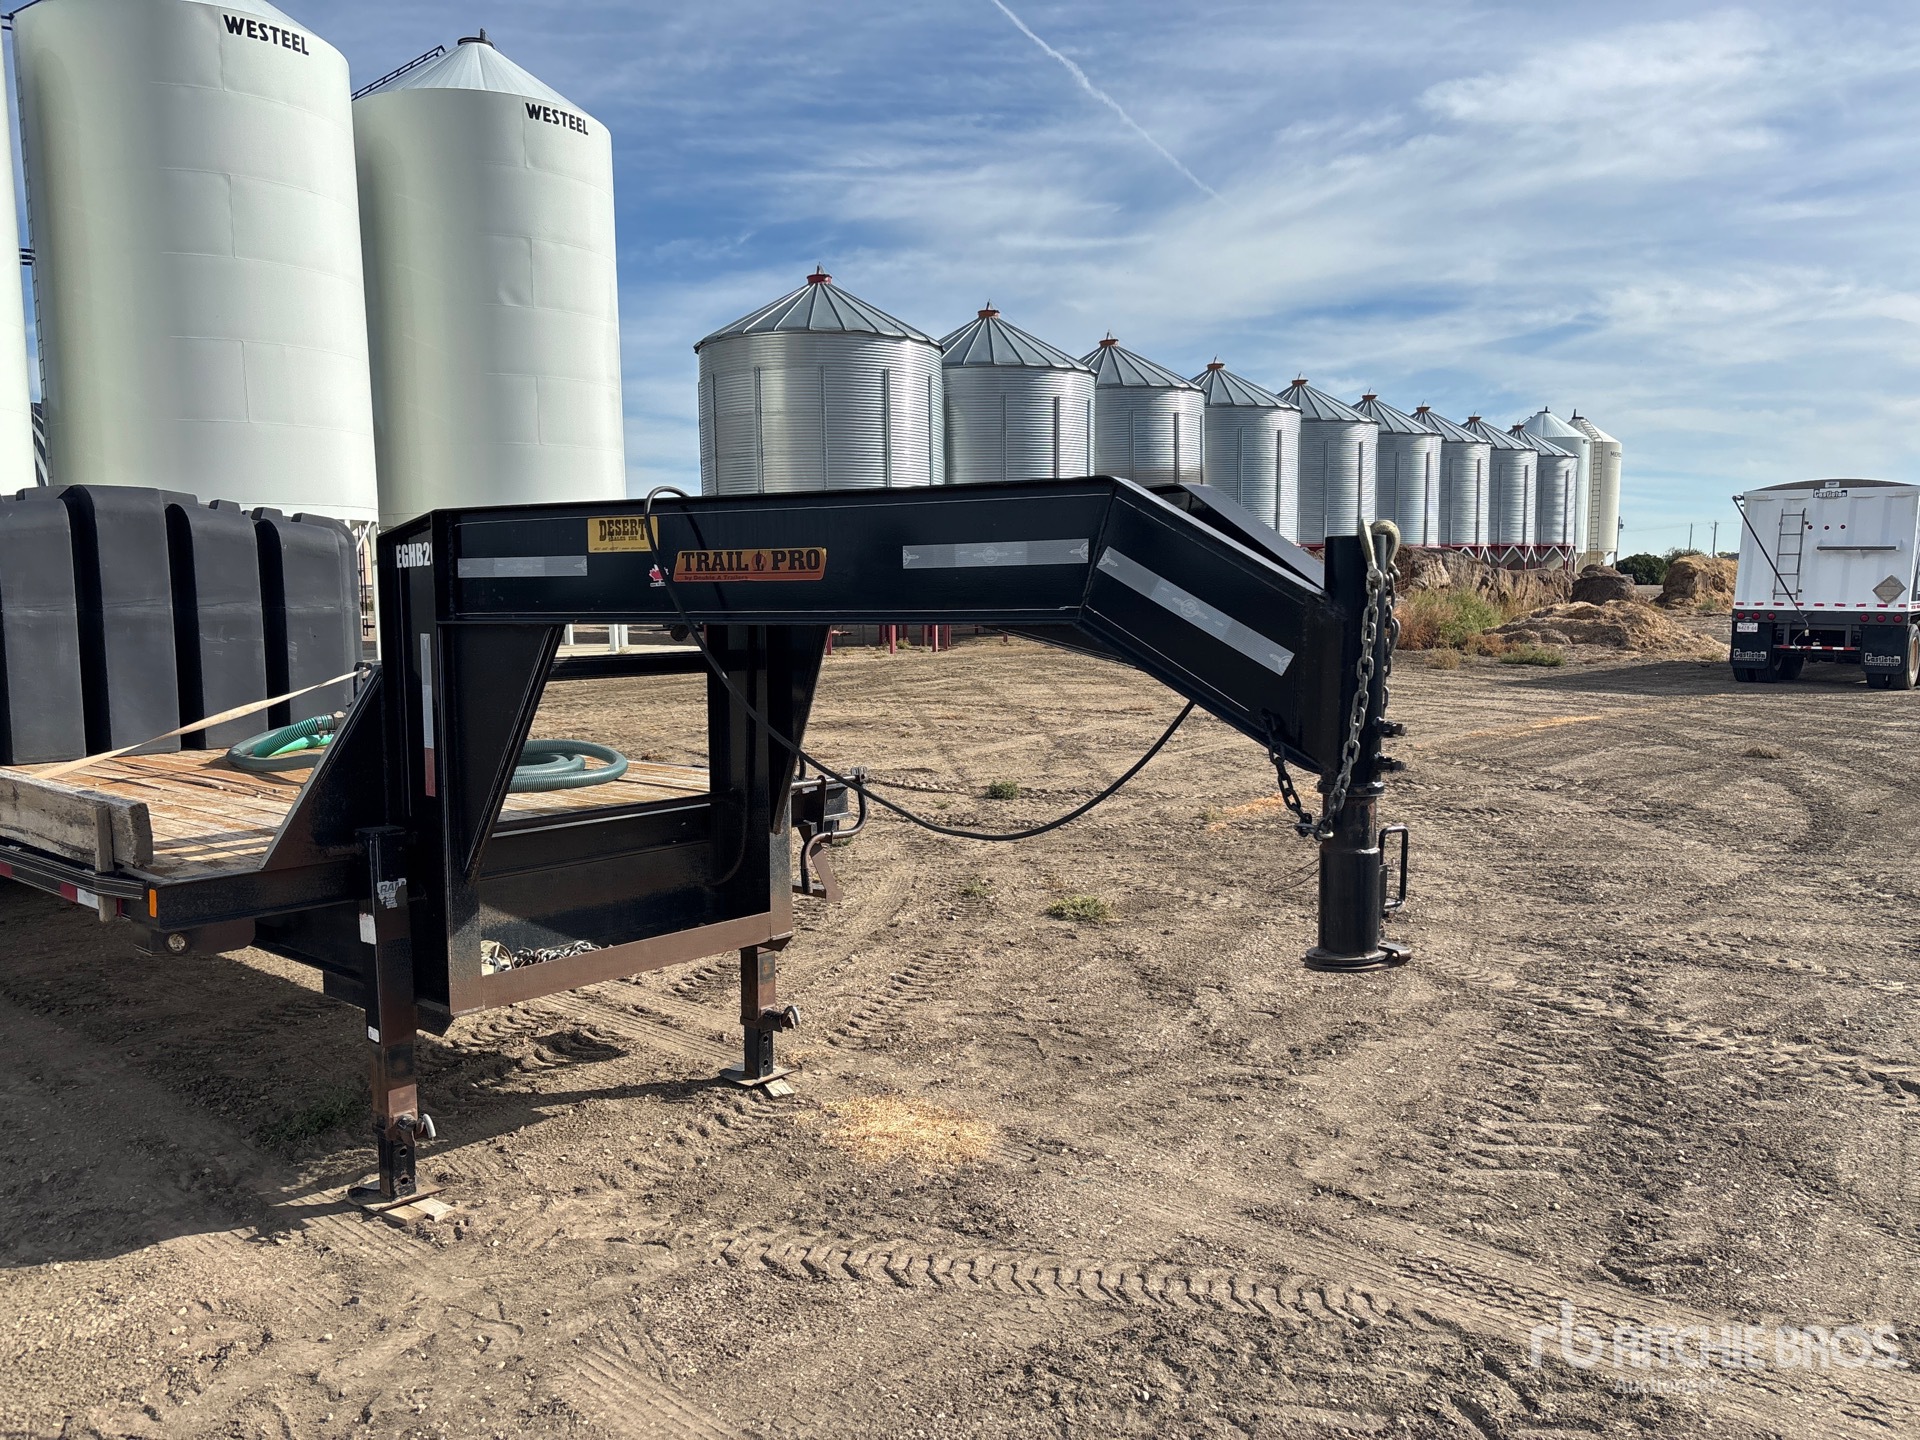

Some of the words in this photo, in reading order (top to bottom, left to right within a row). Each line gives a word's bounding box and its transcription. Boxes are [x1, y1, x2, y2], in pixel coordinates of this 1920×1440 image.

[222, 14, 310, 56] WESTEEL
[525, 102, 589, 136] WESTEEL
[599, 518, 647, 541] DESERT
[395, 541, 433, 568] EGHB2
[682, 551, 749, 572] TRAIL
[771, 549, 821, 571] PRO
